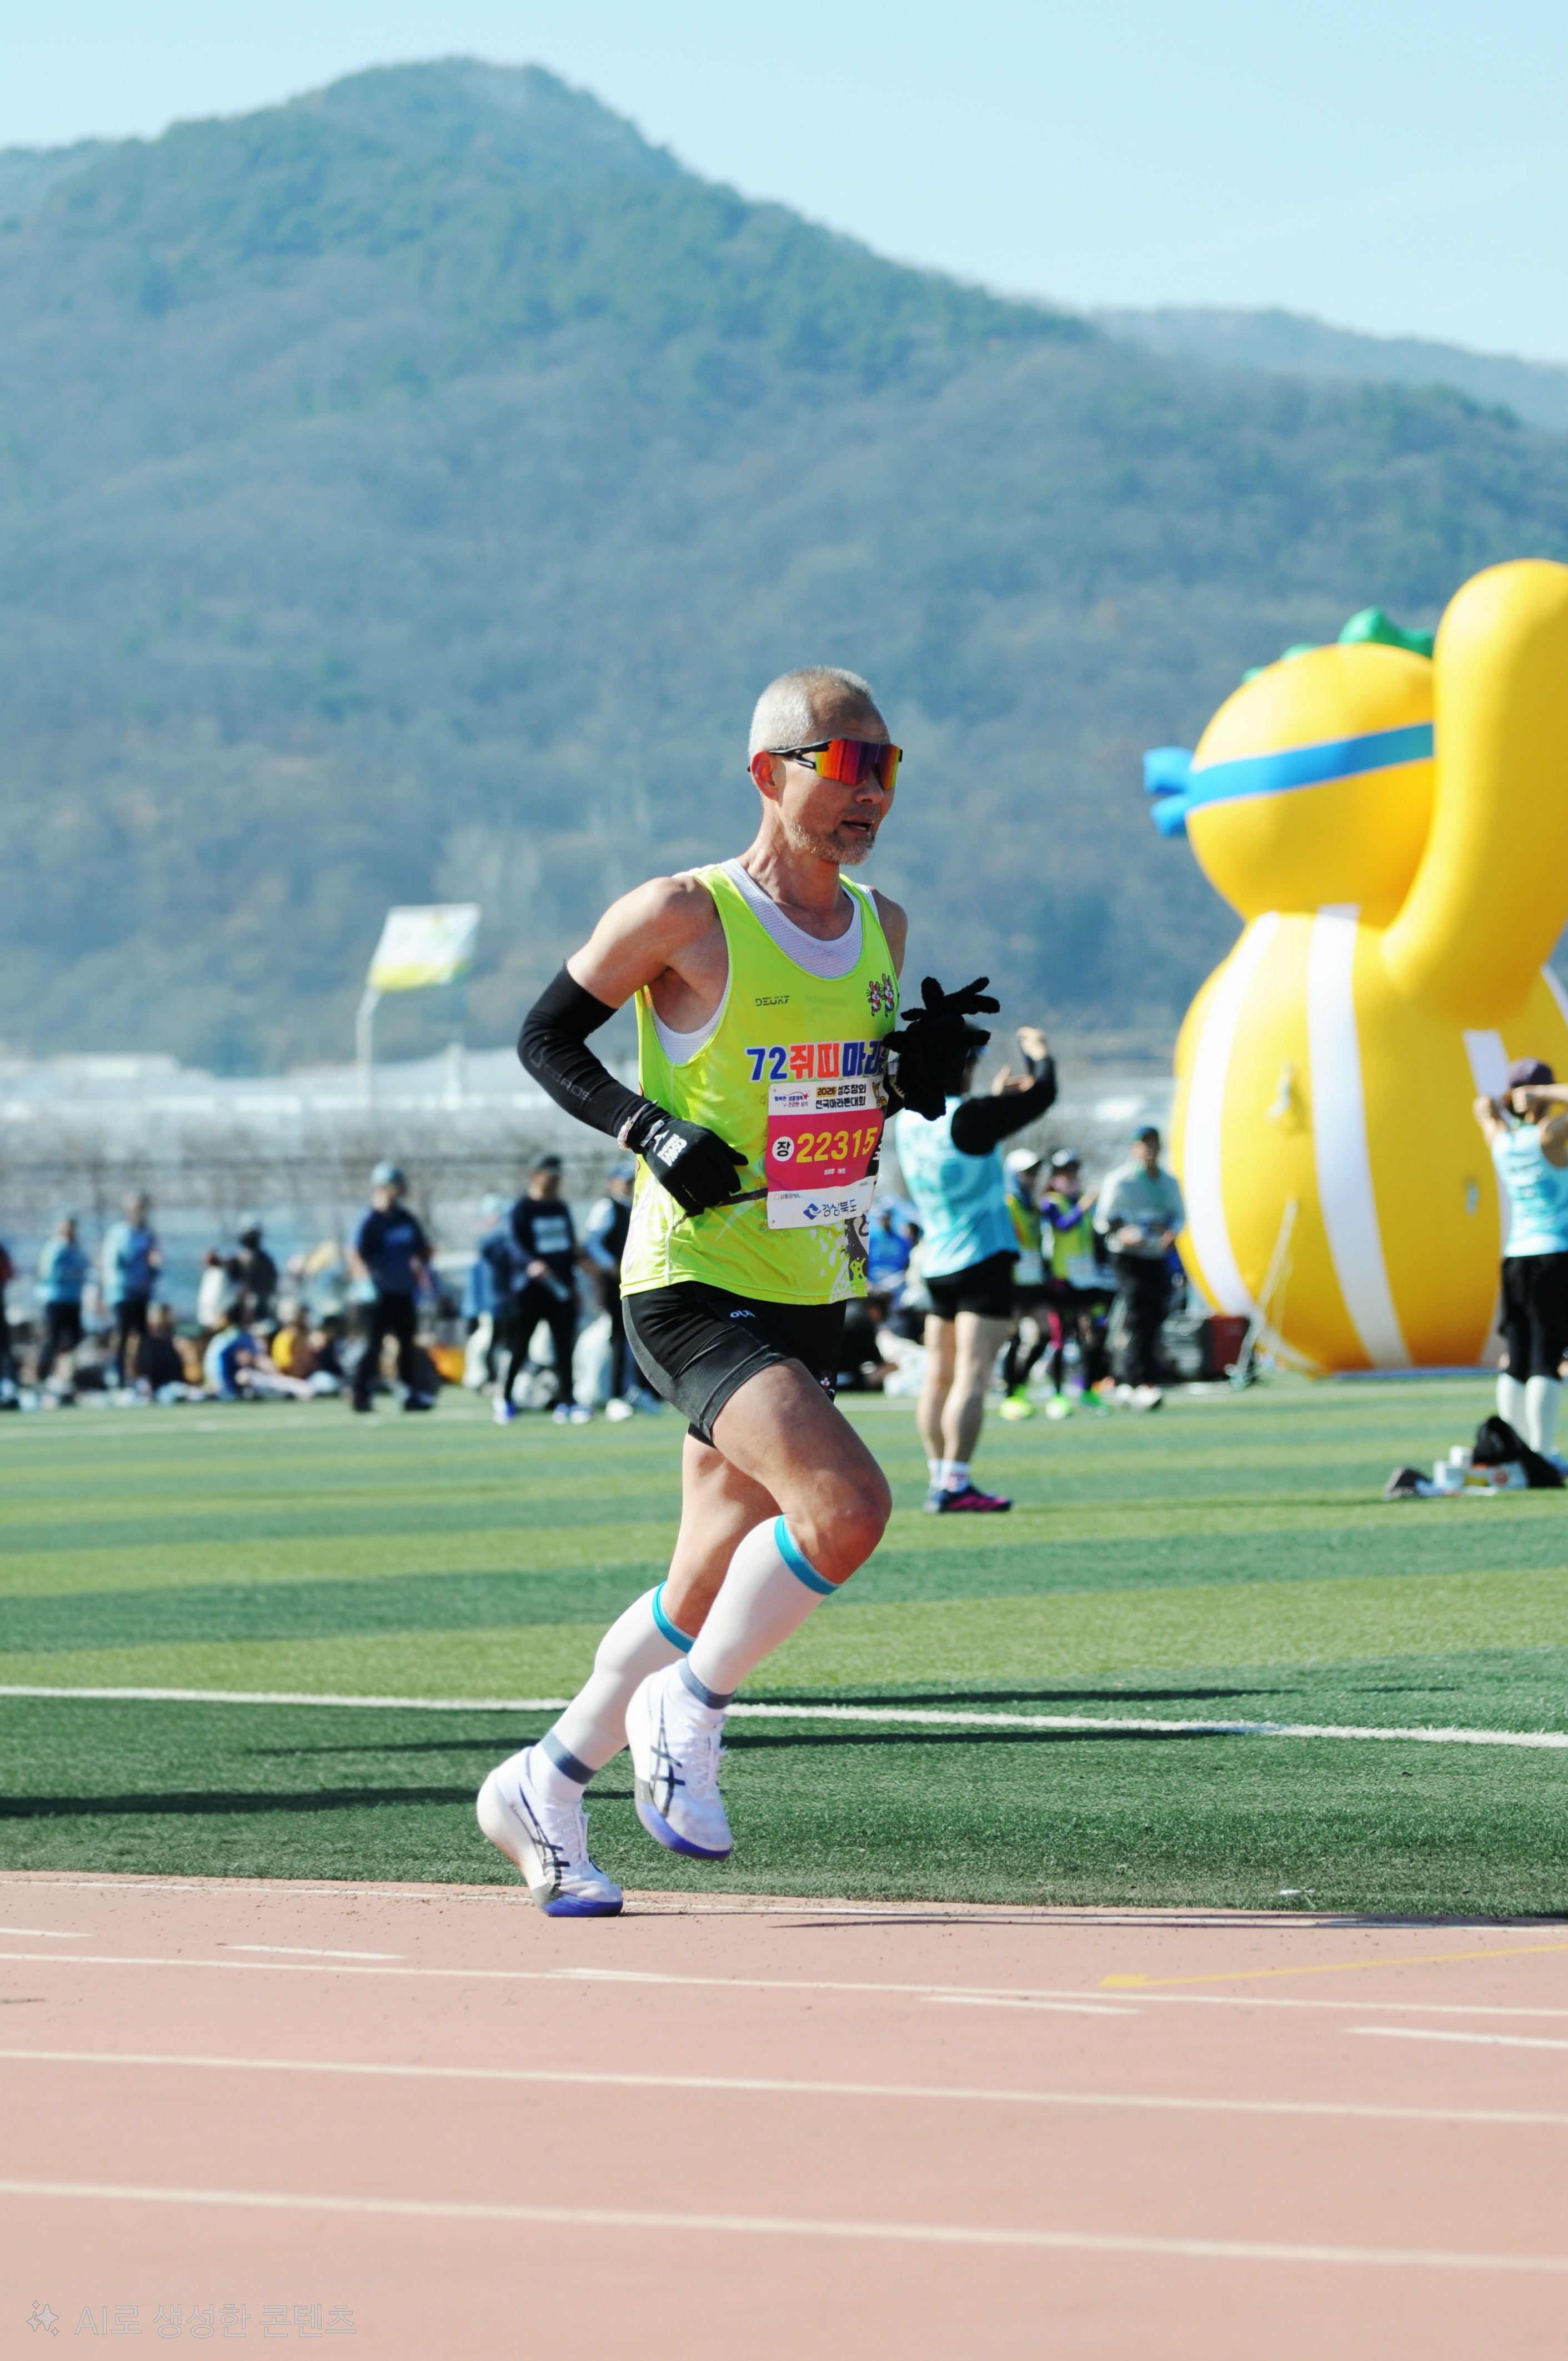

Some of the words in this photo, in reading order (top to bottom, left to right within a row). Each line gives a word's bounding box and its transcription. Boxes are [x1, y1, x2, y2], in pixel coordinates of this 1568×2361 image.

[818, 1087, 836, 1096] 2026
[838, 1084, 866, 1096] 성주참외
[815, 1096, 866, 1109] 전국마라톤대회
[777, 1141, 791, 1157] 장
[796, 1127, 878, 1163] 22315
